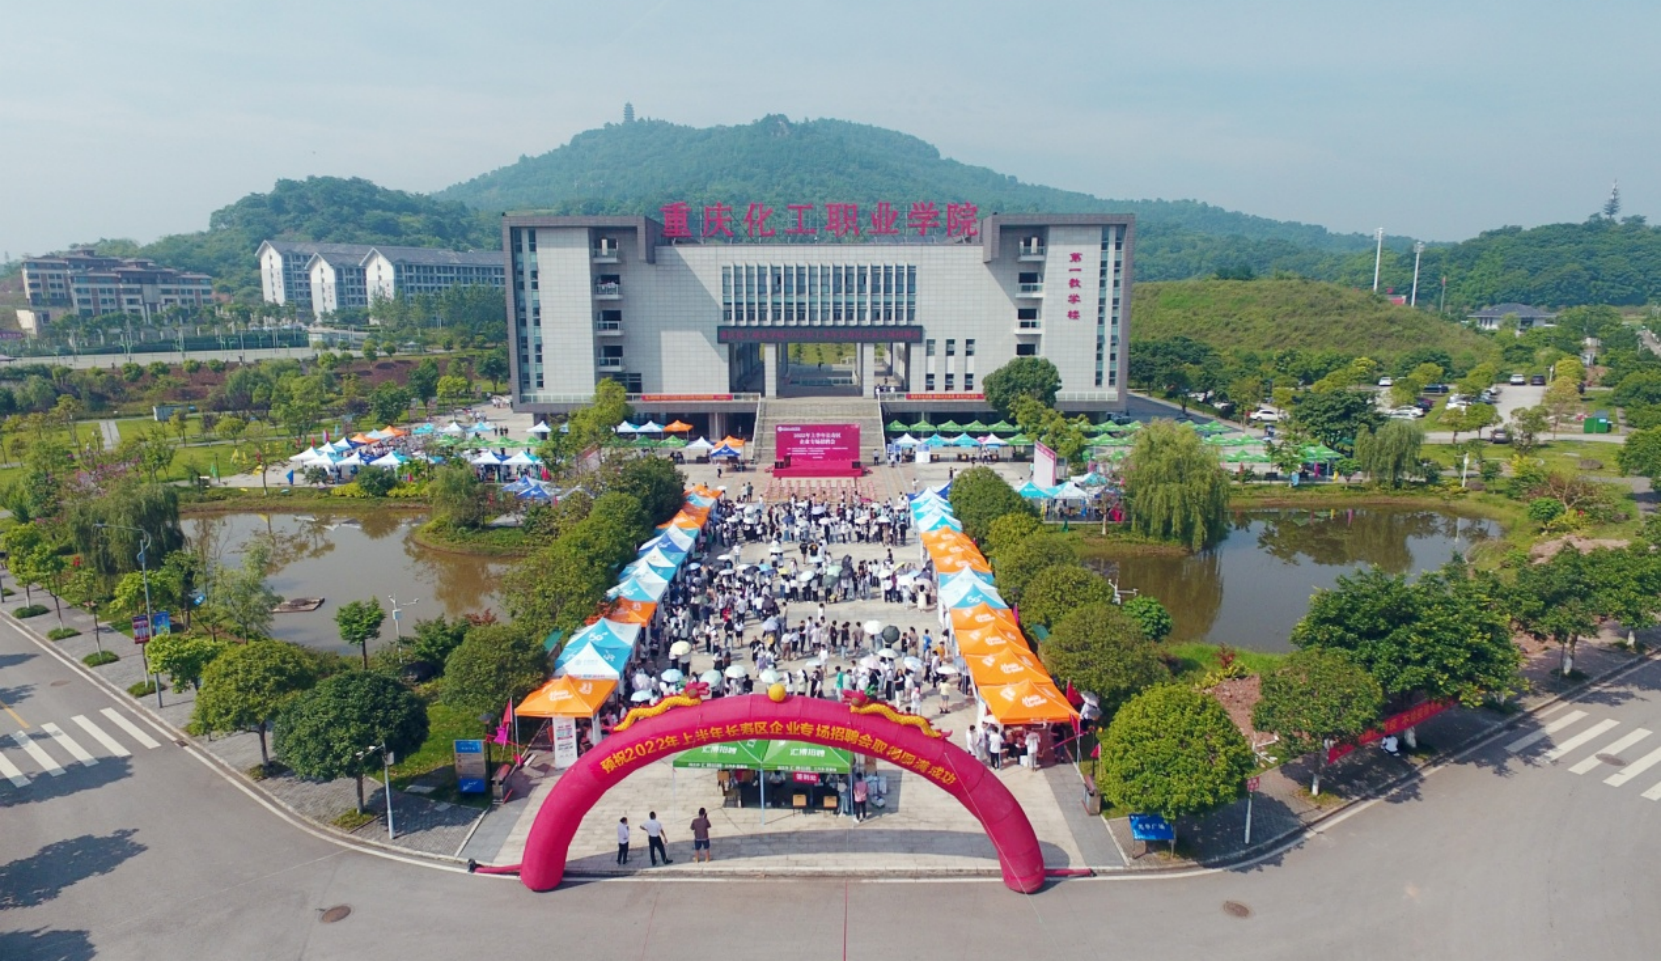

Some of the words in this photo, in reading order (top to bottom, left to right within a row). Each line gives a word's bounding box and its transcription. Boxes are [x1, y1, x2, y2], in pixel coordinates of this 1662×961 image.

[660, 201, 979, 238] 重庆化工职业学院
[1066, 252, 1083, 320] 第一教学楼
[701, 744, 738, 755] 汇博招聘
[790, 747, 826, 757] 汇博招聘
